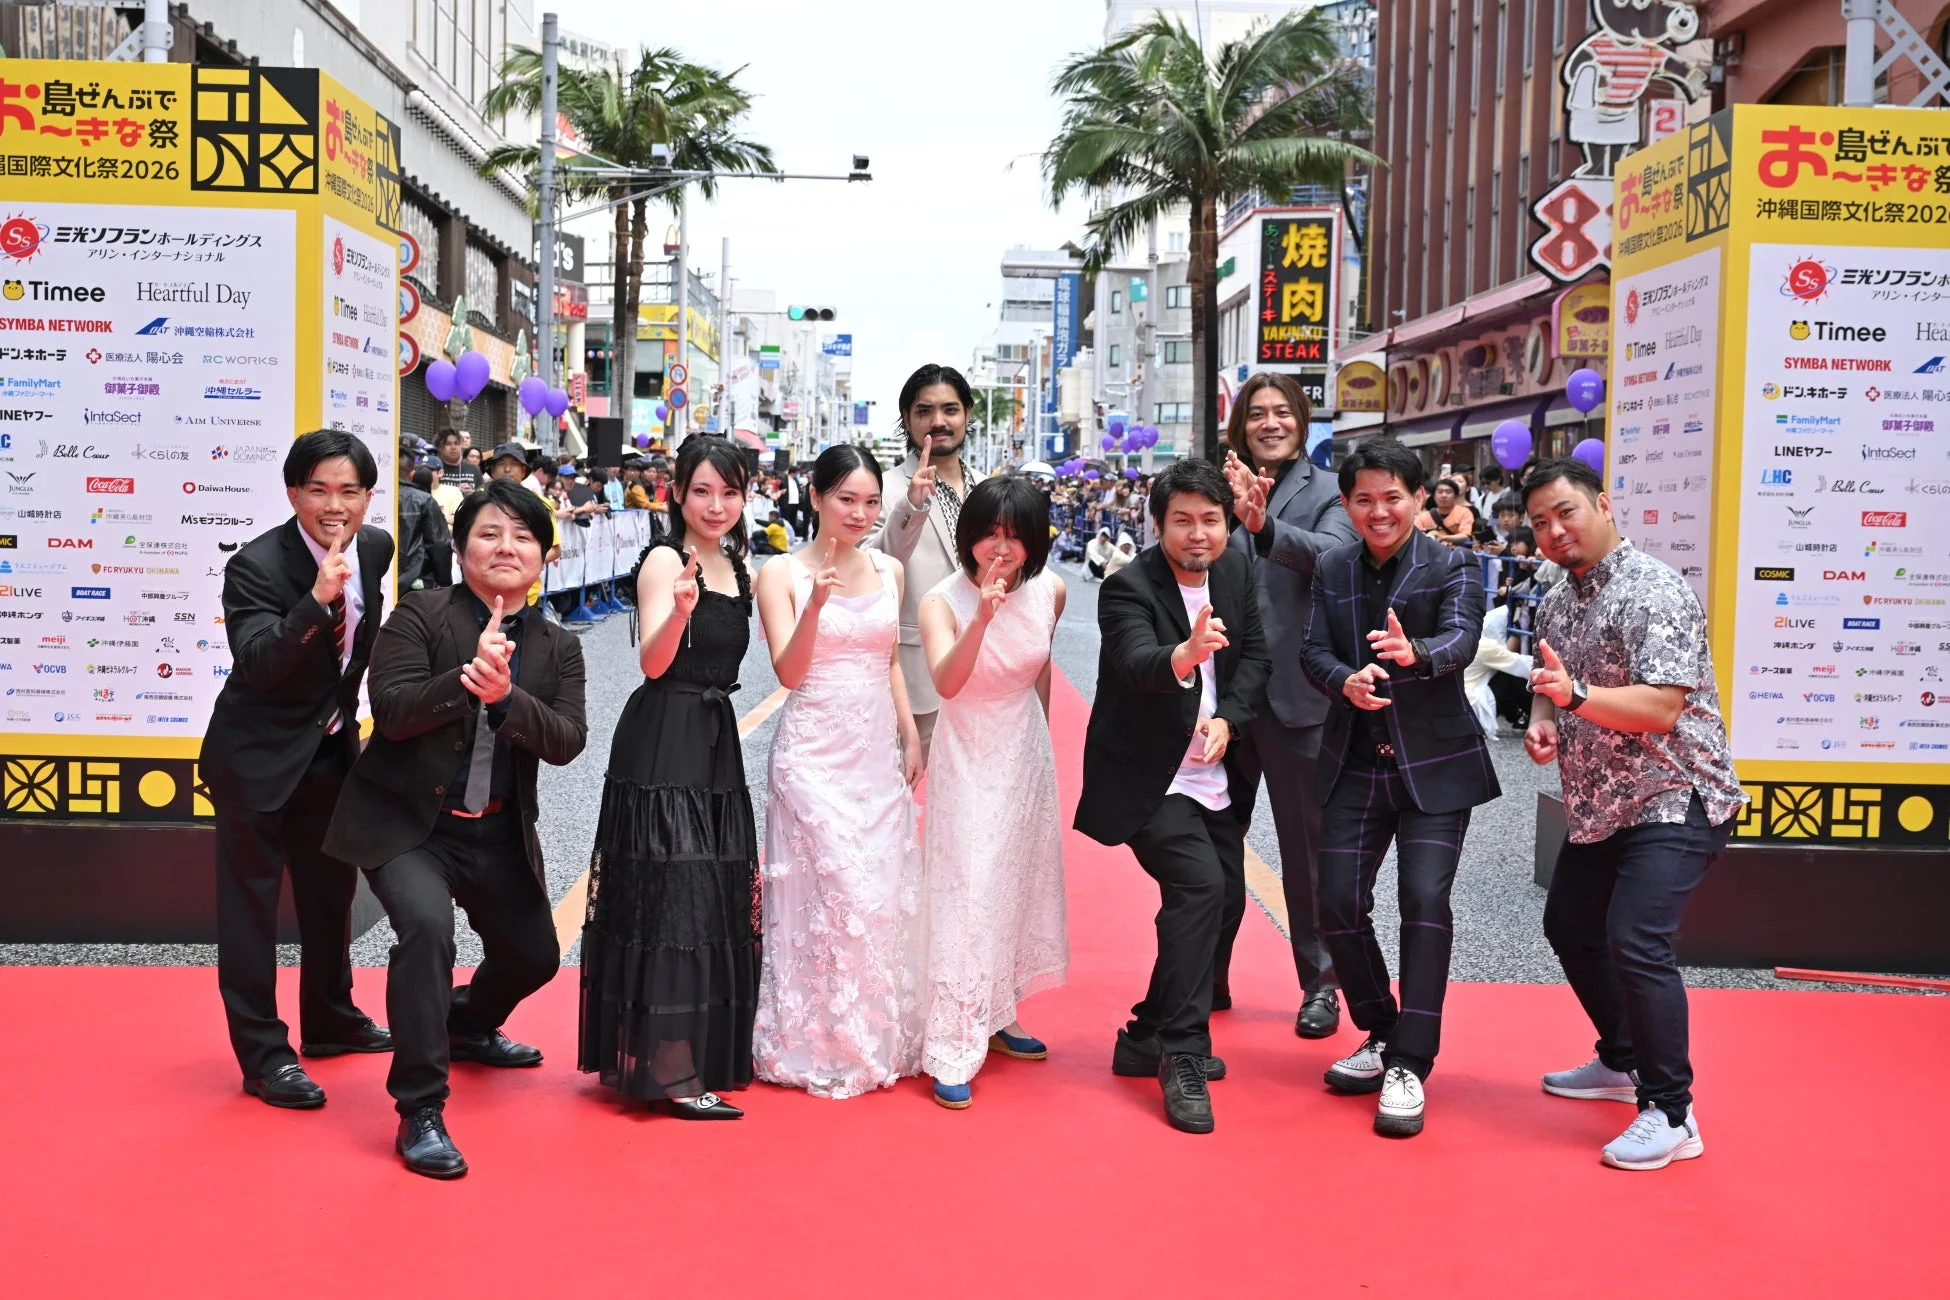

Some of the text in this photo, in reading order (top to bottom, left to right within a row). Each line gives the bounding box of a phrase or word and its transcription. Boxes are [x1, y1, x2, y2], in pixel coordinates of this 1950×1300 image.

[41, 79, 178, 117] 島ぜんぶで
[1756, 198, 1950, 225] 沖縄国際文化祭202
[53, 226, 263, 249] 三光ソフランホールディングス
[1280, 222, 1329, 323] 焼肉
[28, 281, 106, 303] Timee
[136, 282, 252, 310] Heartful Day
[1261, 270, 1278, 323] ステーキ
[339, 296, 358, 322] Timee
[0, 317, 113, 334] SYMBA NETWORK
[1814, 321, 1887, 343] Timee
[174, 326, 256, 340] 沖縄空輸株式会社
[1262, 325, 1323, 342] YAKINIKU
[1261, 343, 1321, 360] STEAK
[1633, 341, 1657, 360] Timee
[105, 352, 184, 365] 医療法人 陽心会
[1784, 356, 1893, 373] SYMBA NETWORK
[8, 377, 61, 390] FamilyMart
[104, 382, 160, 397] 御菓子御殿
[90, 411, 143, 425] IntaSect
[1791, 415, 1841, 427] FamilyMart
[1882, 419, 1936, 433] 御菓子御殿
[1774, 446, 1833, 458] LINEヤフー
[1867, 446, 1917, 460] IntaSect
[198, 484, 251, 495] Daiwa House
[48, 538, 93, 549] DAM
[103, 566, 180, 576] FC RYUKYU OKINAWA
[1759, 569, 1791, 579] COSMIC
[1823, 570, 1867, 581] DAM
[1874, 597, 1884, 606] FC
[1884, 598, 1913, 606] RYUKYU
[174, 612, 196, 620] SSN
[42, 635, 66, 645] meiji
[43, 664, 67, 675] OCVB
[1812, 665, 1836, 675] meiji
[1758, 692, 1784, 701] HEIWA
[1813, 694, 1836, 704] OCVB
